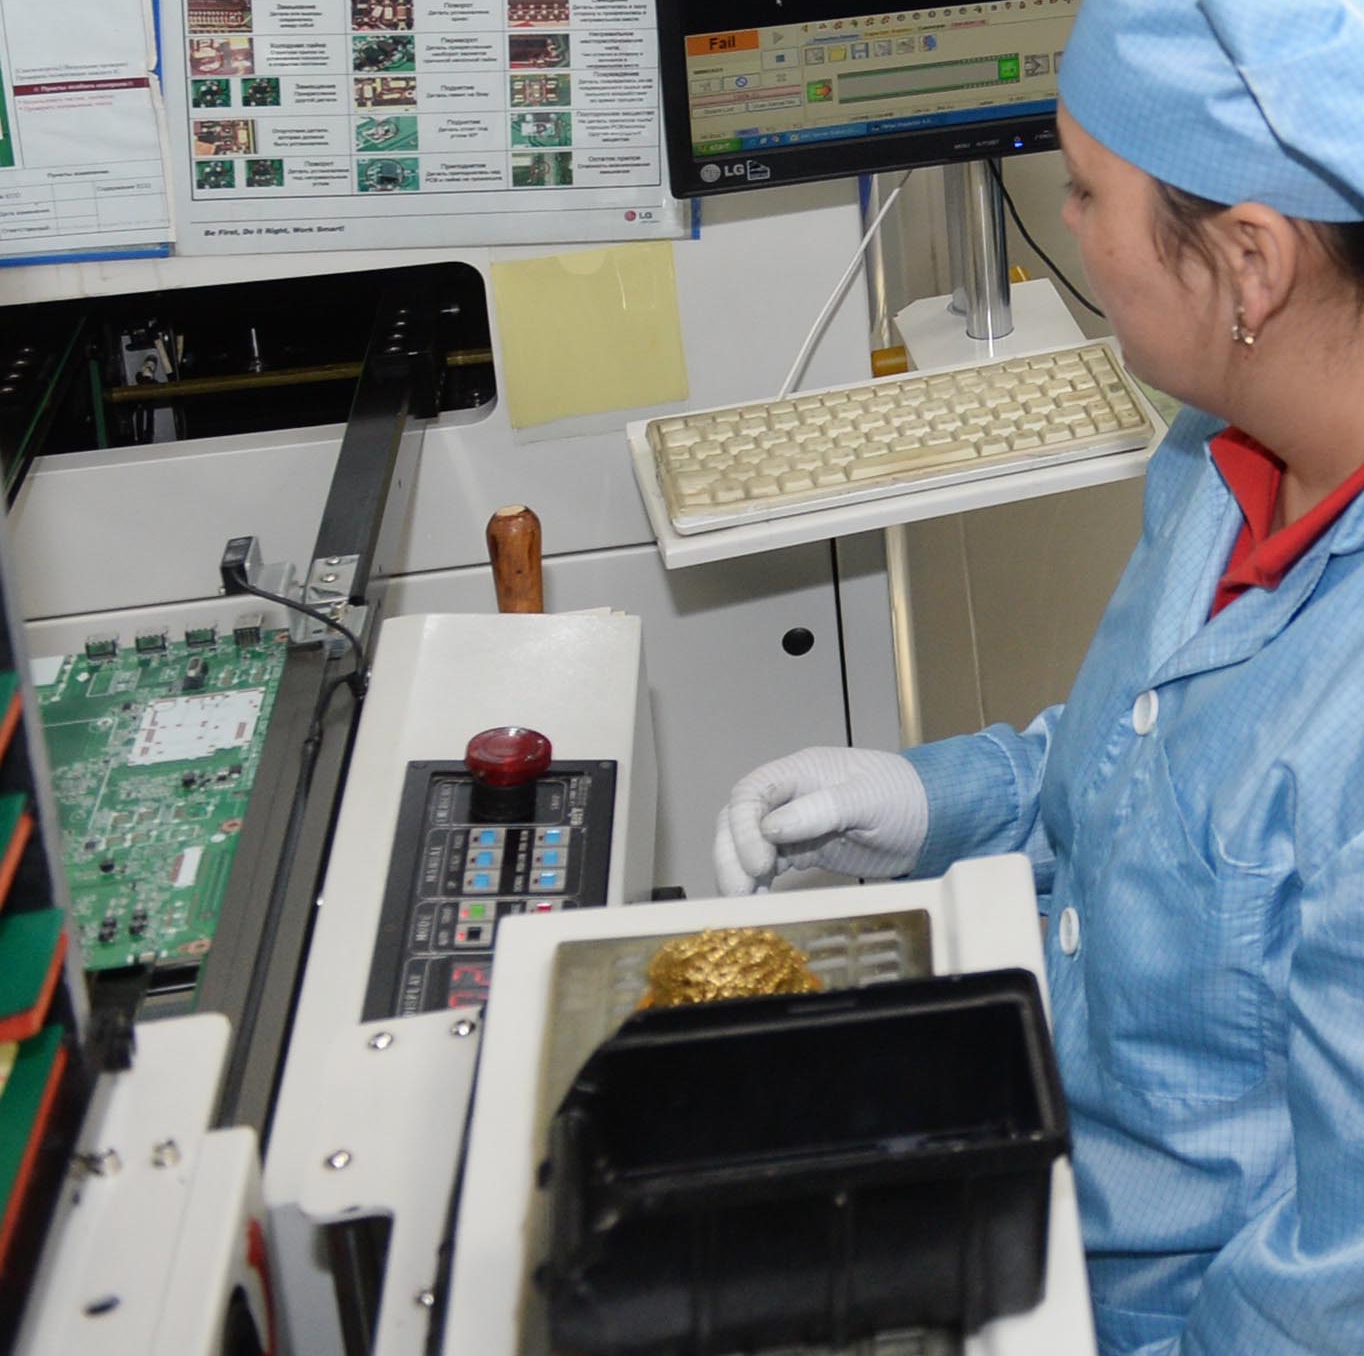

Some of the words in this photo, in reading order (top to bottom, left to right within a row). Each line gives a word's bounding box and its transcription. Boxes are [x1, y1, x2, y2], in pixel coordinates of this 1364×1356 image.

[709, 36, 735, 50] Fail
[724, 164, 745, 177] LG
[416, 914, 432, 942] MODE
[403, 973, 422, 1017] DISPLAY
